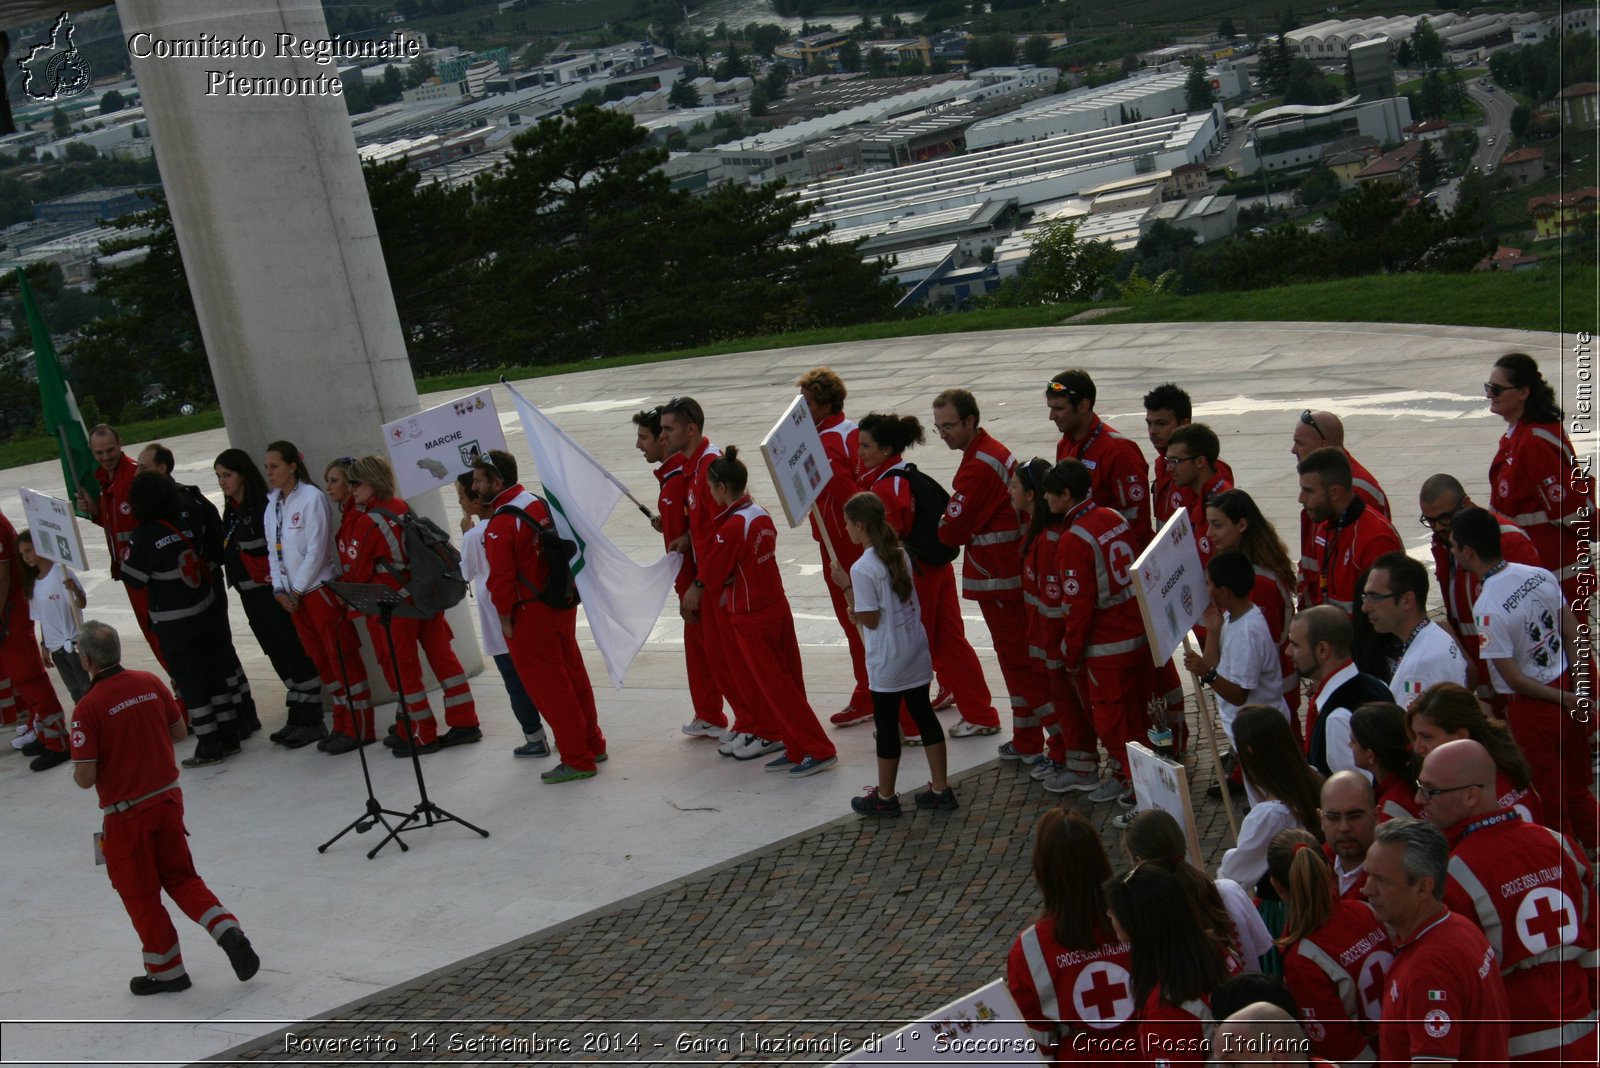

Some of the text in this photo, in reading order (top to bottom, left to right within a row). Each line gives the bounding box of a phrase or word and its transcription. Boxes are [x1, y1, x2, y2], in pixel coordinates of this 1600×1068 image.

[424, 431, 463, 450] MARCHE
[1160, 564, 1185, 598] SARDEGNA
[1501, 878, 1522, 898] CROCE
[1056, 950, 1081, 968] CROCE
[1340, 945, 1361, 967] CROCE
